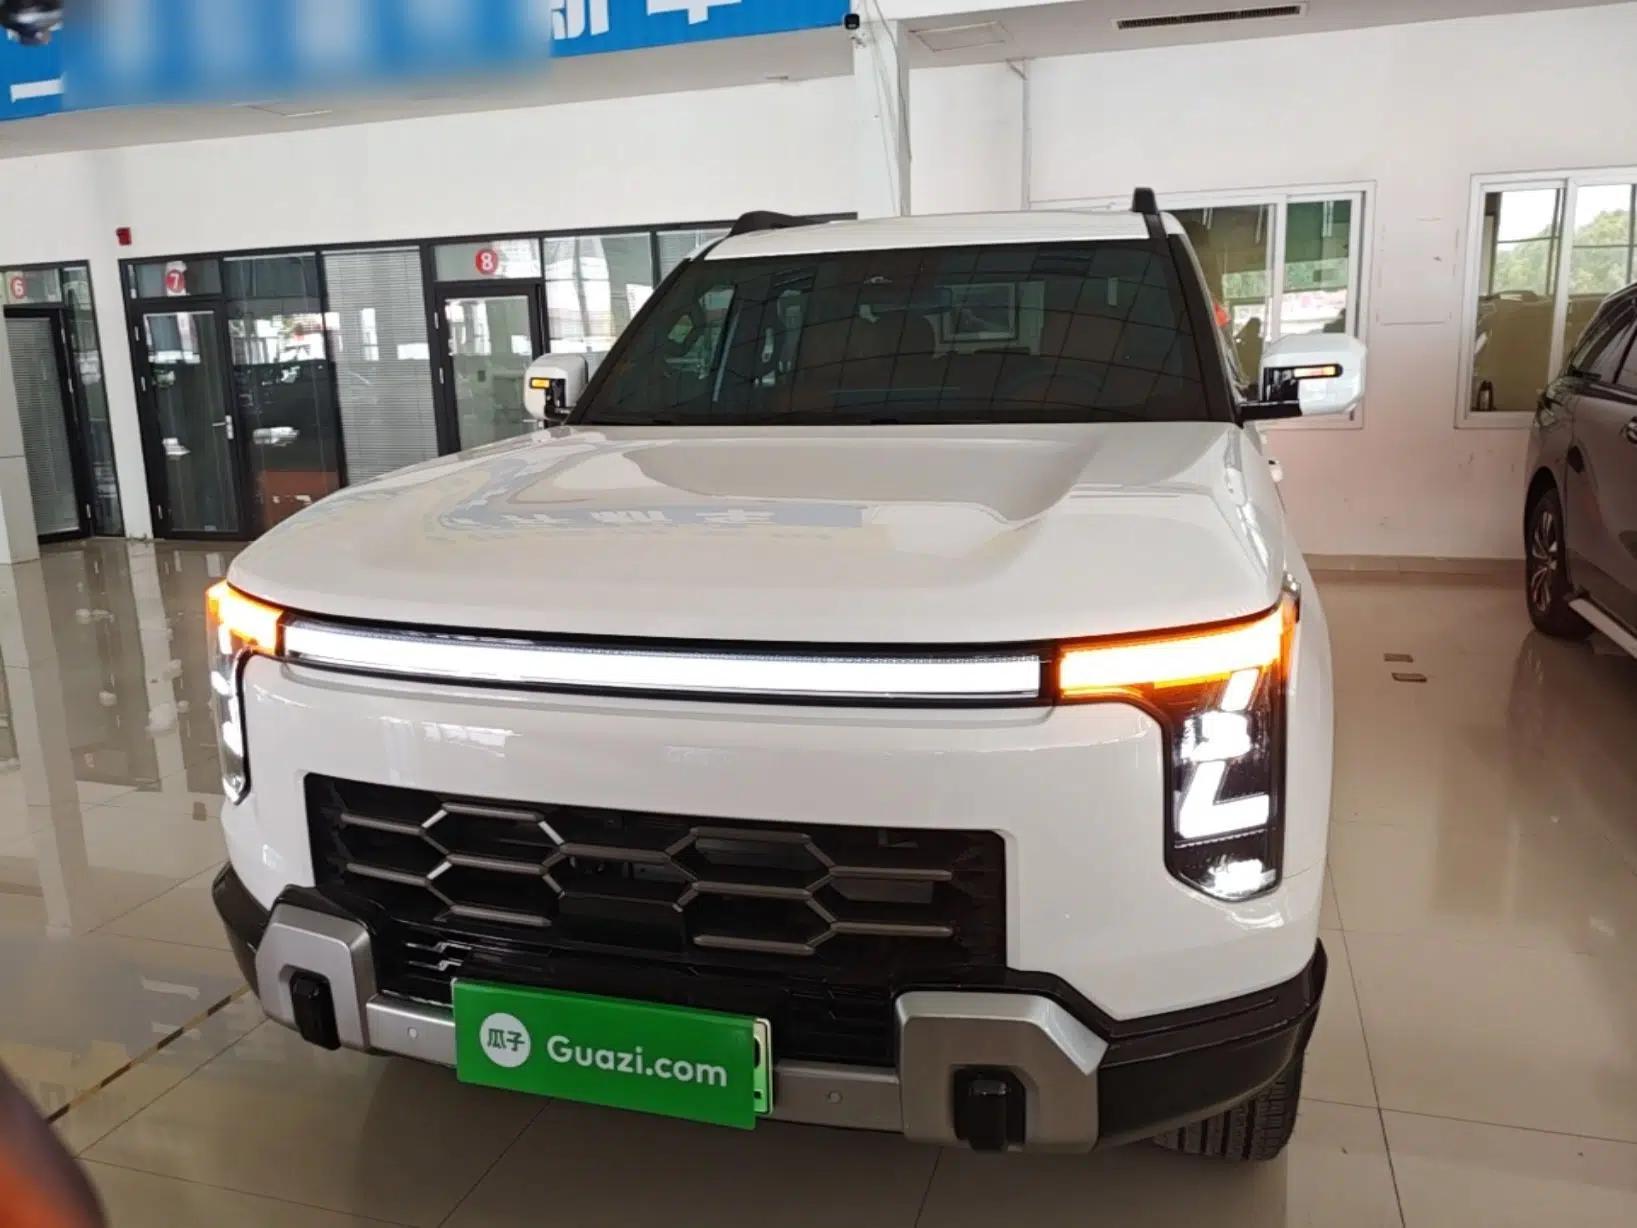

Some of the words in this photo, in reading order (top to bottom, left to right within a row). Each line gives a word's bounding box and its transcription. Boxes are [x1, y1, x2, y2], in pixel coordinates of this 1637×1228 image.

[481, 252, 493, 271] 8
[14, 279, 24, 297] 6
[170, 272, 180, 289] 7
[487, 1028, 526, 1052] 瓜子
[546, 1035, 727, 1088] Guazi.com
